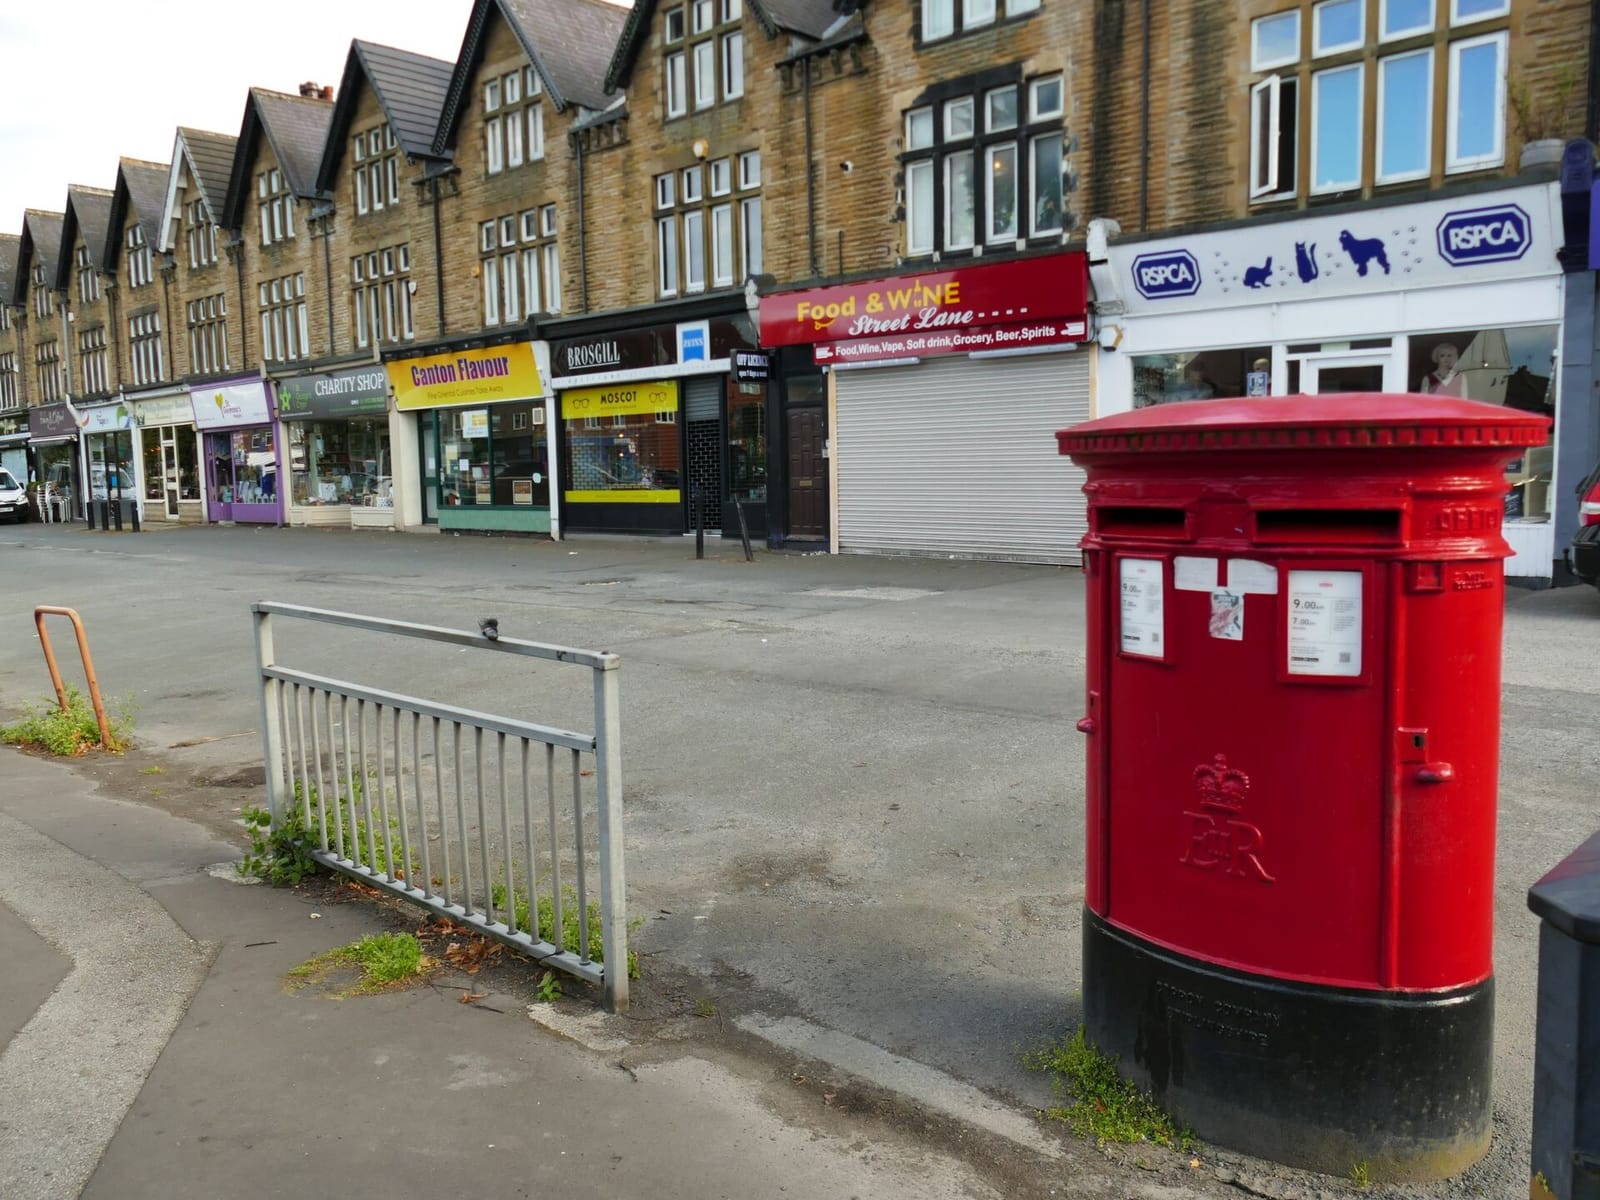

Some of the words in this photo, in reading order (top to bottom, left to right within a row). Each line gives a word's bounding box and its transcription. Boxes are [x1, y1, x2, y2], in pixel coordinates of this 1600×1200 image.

[1448, 216, 1521, 250] RSPCA
[1140, 262, 1192, 286] RSPCA
[796, 296, 856, 322] Food
[865, 292, 885, 314] &
[848, 313, 911, 336] Street
[913, 307, 974, 329] Lane
[567, 341, 621, 367] BROSGILL
[906, 339, 925, 350] Soft
[315, 376, 356, 396] CHARITY
[357, 372, 384, 391] SHOP
[411, 362, 457, 387] Canton
[457, 356, 509, 381] Flavour
[601, 391, 637, 404] MOSCOT
